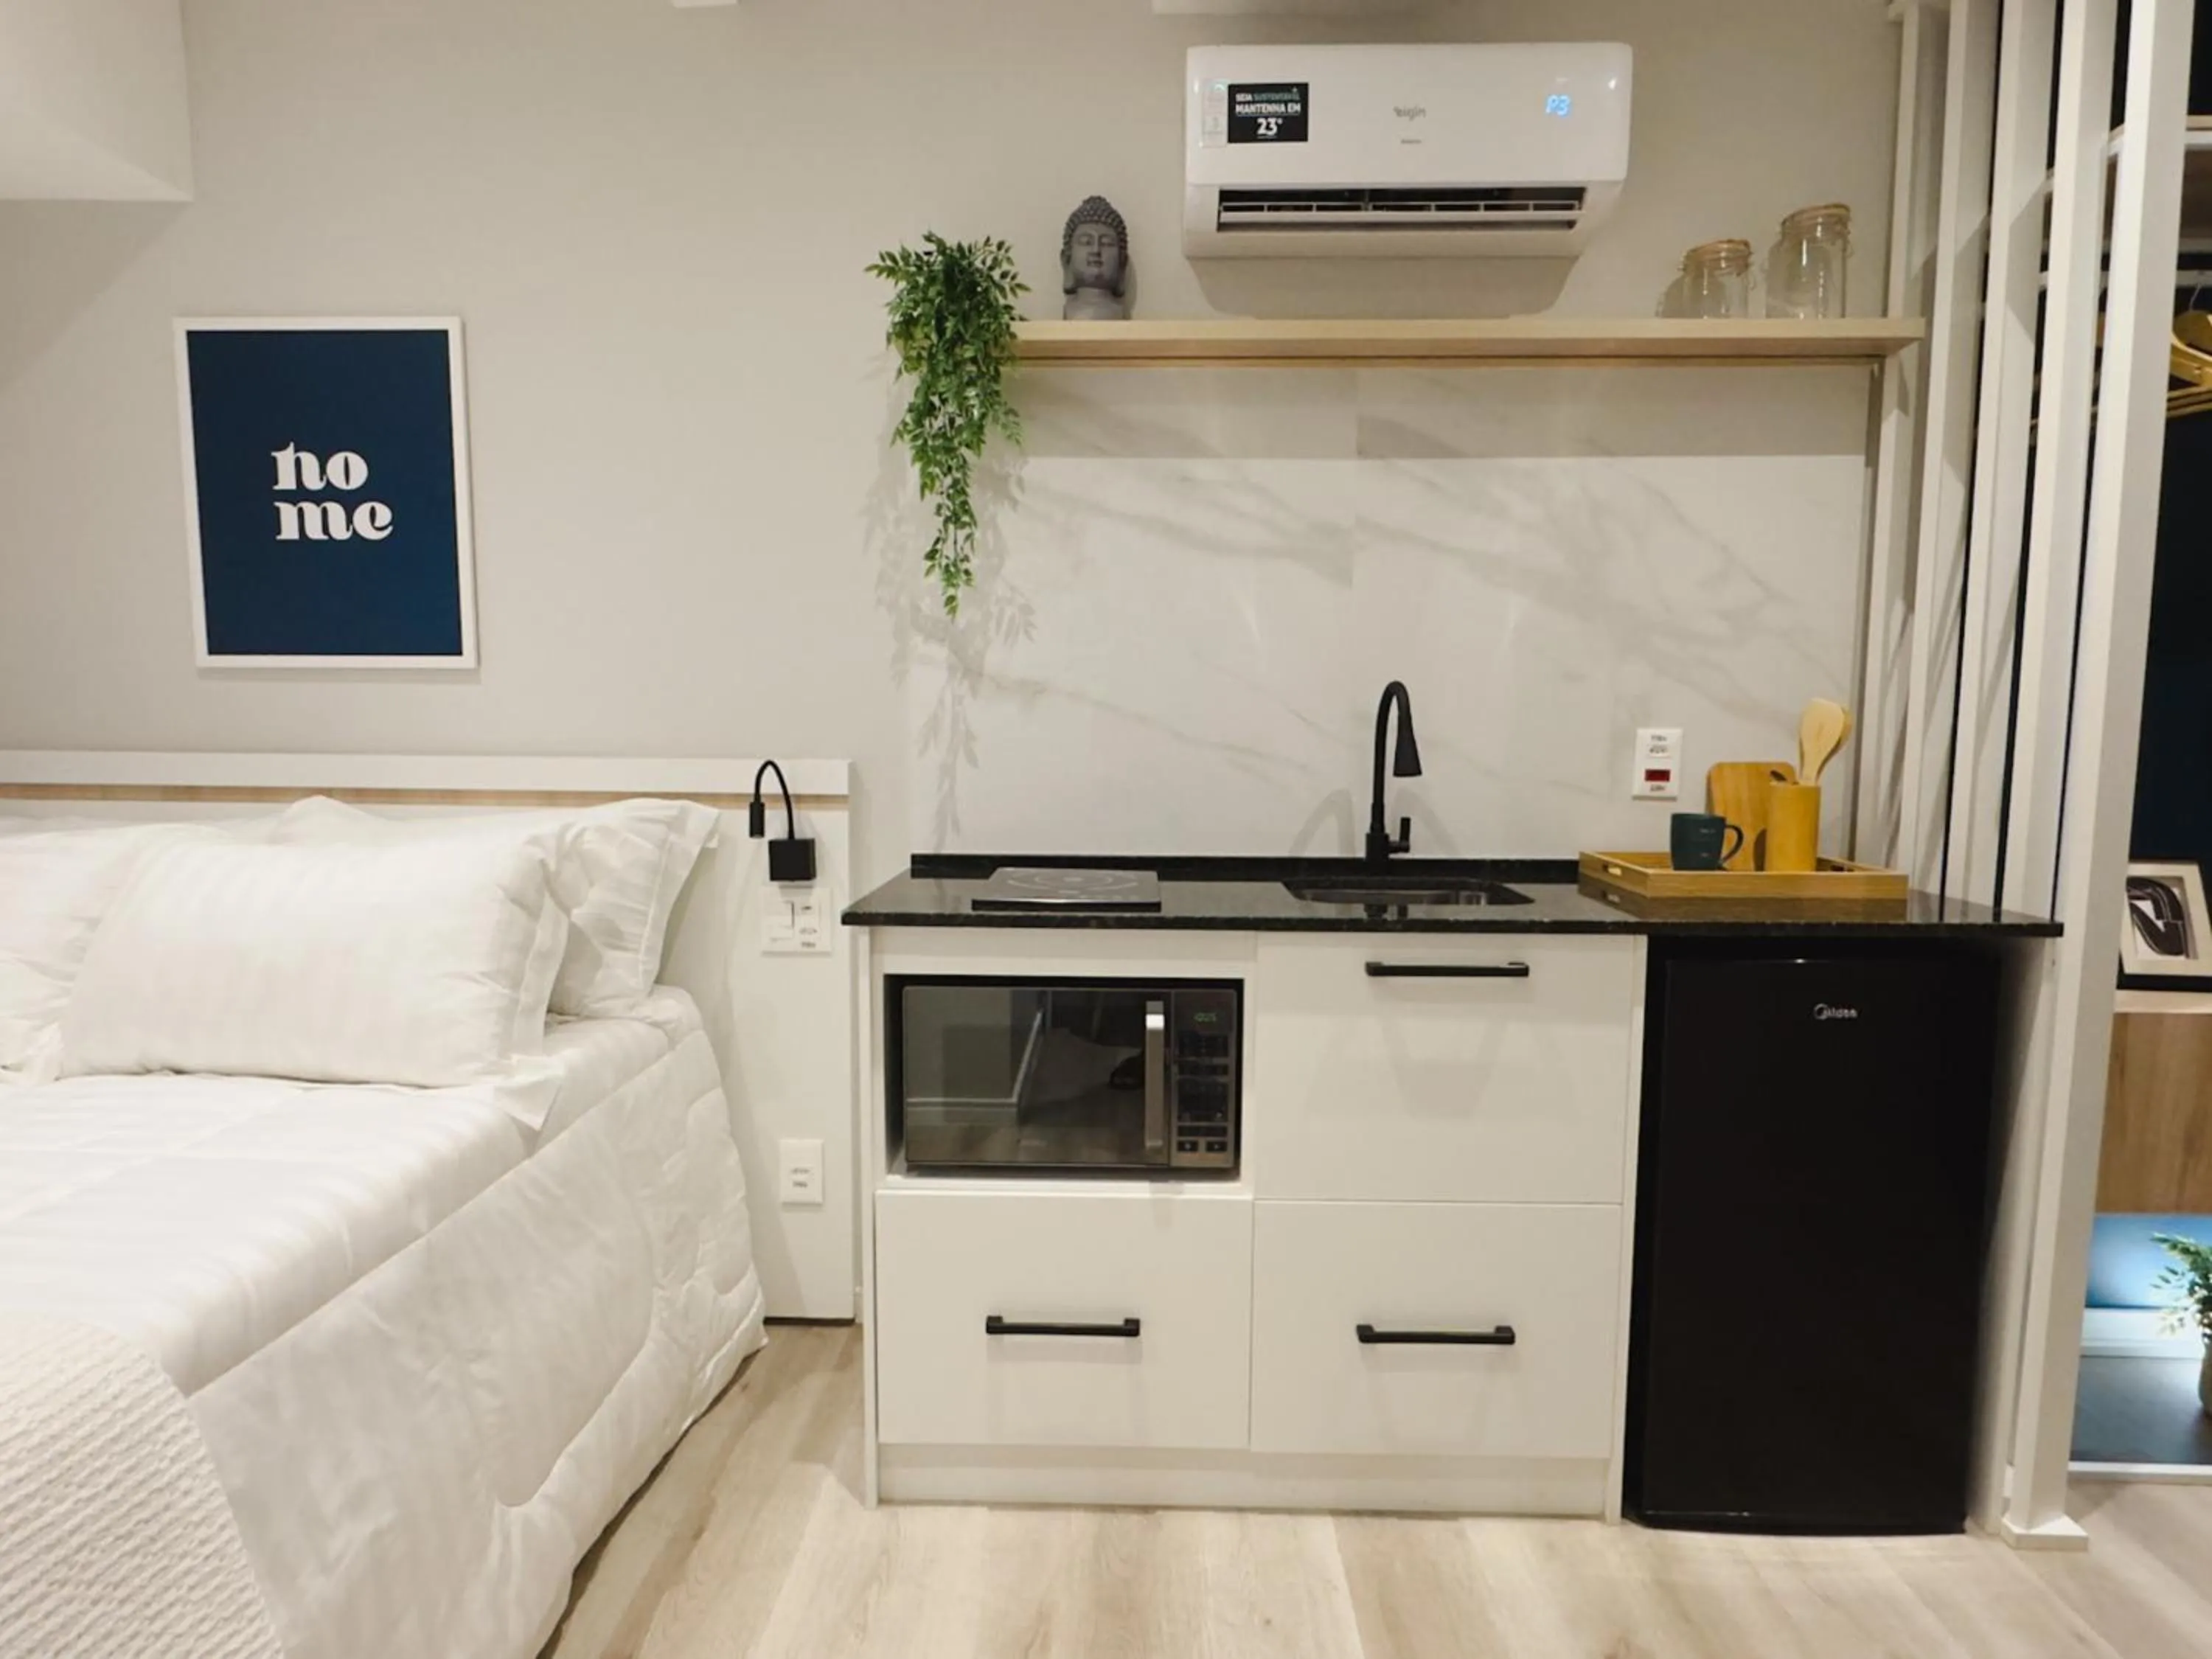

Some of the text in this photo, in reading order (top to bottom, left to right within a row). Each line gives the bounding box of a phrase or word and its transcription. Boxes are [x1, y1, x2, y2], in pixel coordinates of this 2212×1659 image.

[1236, 102, 1301, 113] MANTENHA EM
[1545, 95, 1571, 116] P3
[271, 441, 369, 490] ho
[274, 501, 394, 540] me
